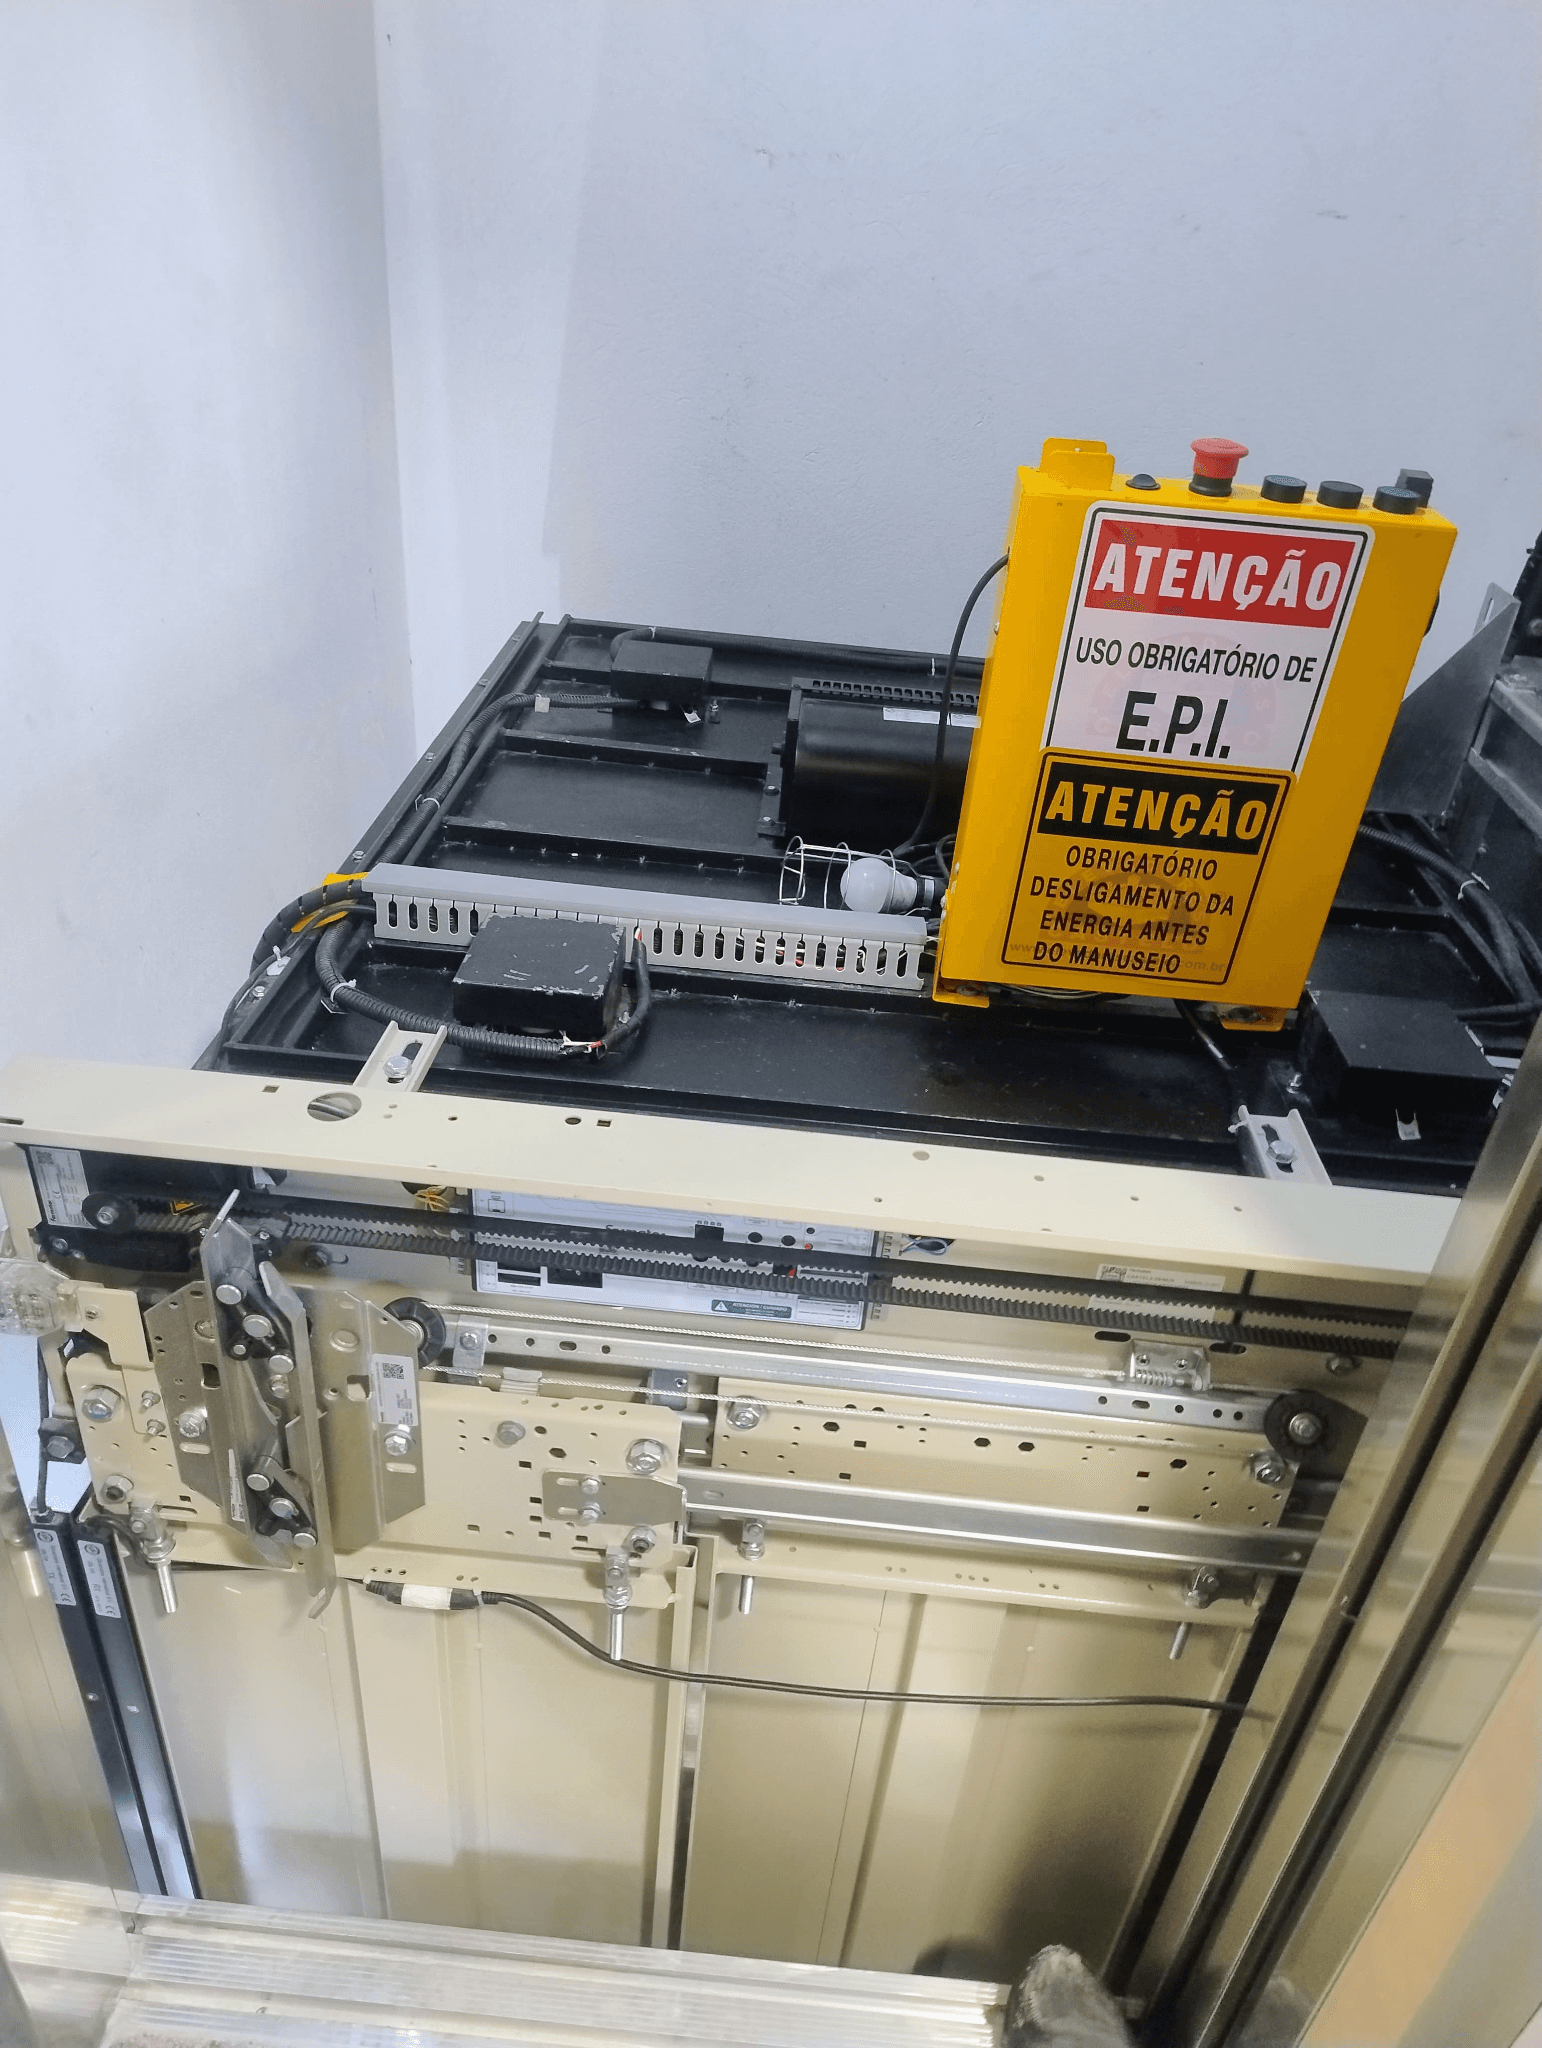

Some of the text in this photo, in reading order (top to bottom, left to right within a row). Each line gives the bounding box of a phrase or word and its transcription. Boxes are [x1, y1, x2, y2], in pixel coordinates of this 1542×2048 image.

[1092, 542, 1342, 611] ATENÇÃO
[1076, 636, 1318, 683] USO OBRIGATÓRIO DE
[1115, 690, 1231, 760] E.P.I.
[1044, 780, 1267, 840] ATENÇÃO
[1066, 845, 1218, 881] OBRIGATÓRIO
[1029, 875, 1234, 917] DESLIGAMENTO DA
[1039, 909, 1210, 946] ENERGIA ANTES
[1032, 940, 1064, 963] DO
[1068, 944, 1181, 975] MANUSEIO
